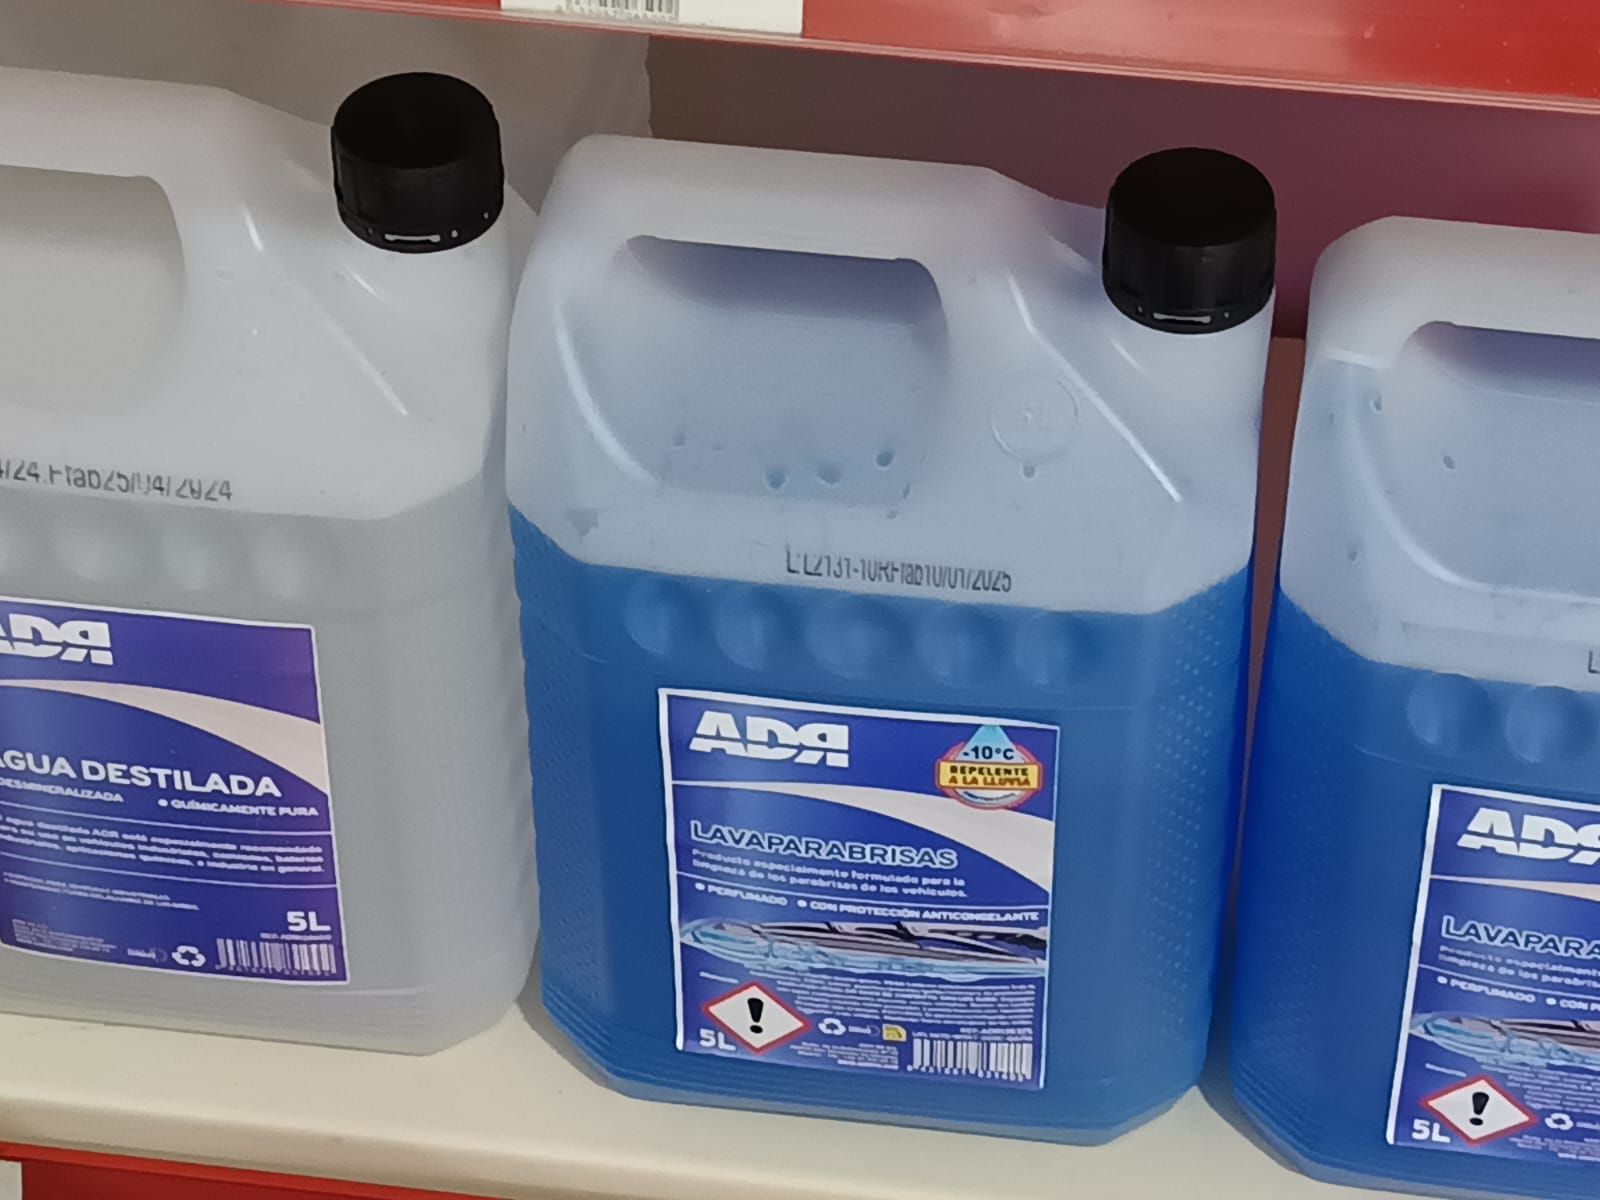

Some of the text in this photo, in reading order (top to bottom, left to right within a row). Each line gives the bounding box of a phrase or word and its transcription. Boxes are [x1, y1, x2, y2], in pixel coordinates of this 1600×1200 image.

[0, 614, 113, 665] DR
[690, 711, 849, 768] ADR
[0, 750, 282, 797] GUA DESTILADA
[948, 775, 1031, 787] A LA LLUVIA
[949, 765, 1029, 776] REPELENTE
[278, 806, 319, 817] PURA
[690, 820, 958, 869] LAVAPARABRISAS
[707, 884, 788, 906] PERFUMADO
[809, 900, 838, 913] CON
[921, 909, 1039, 921] ANTICONGELANTE
[286, 911, 332, 932] 5L
[1450, 979, 1536, 1003] PERFUMADO
[698, 1028, 737, 1052] 5L
[1412, 1118, 1450, 1144] 5L
